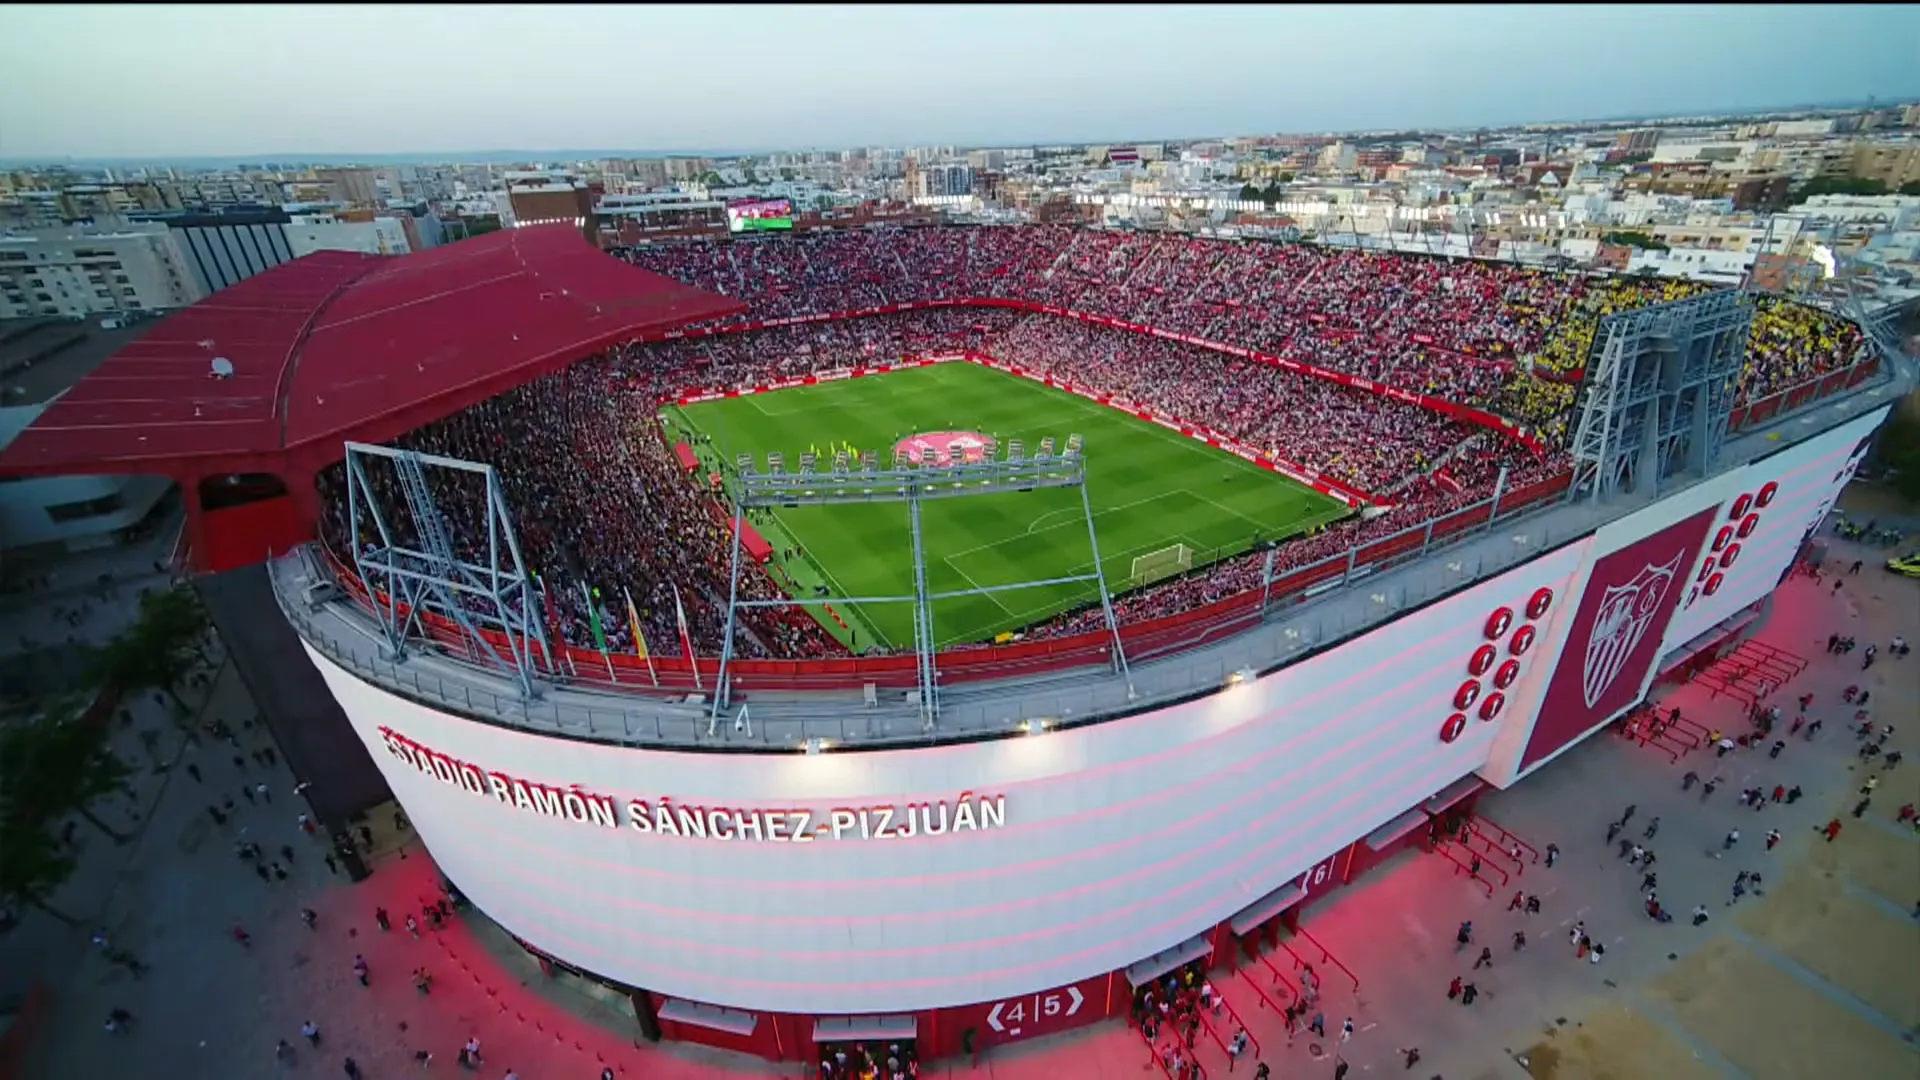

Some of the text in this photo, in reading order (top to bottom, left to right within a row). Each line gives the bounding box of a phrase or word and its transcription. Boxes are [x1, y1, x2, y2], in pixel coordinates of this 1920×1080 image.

[378, 725, 1006, 842] ESTADIO RAMÓN SÁNCHEZ-PIZJUÁN
